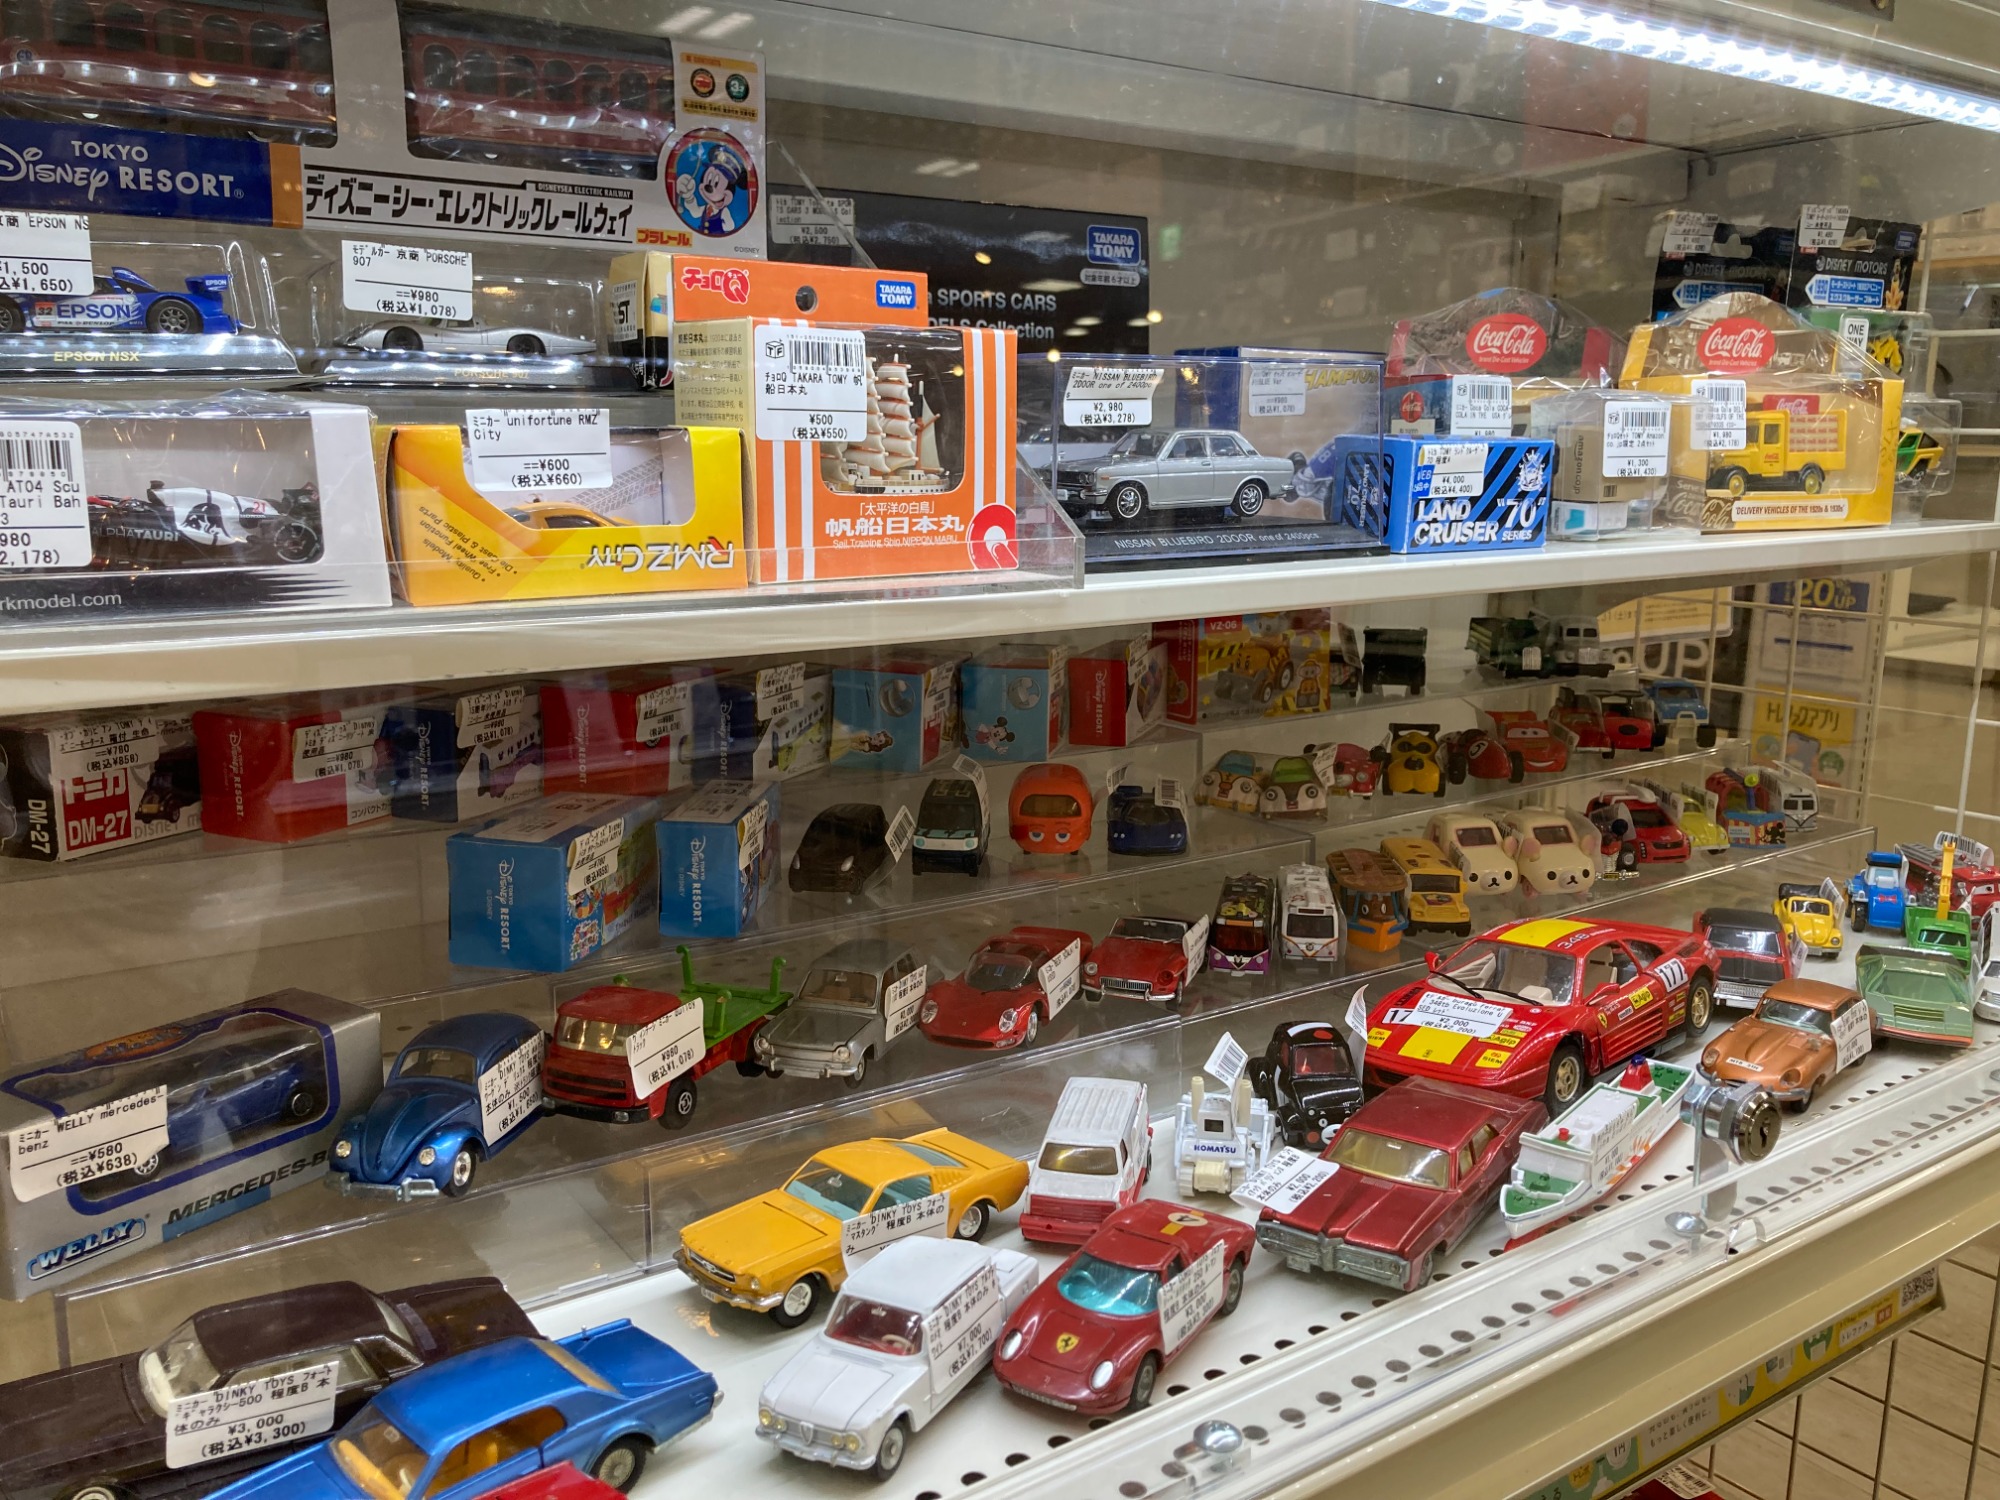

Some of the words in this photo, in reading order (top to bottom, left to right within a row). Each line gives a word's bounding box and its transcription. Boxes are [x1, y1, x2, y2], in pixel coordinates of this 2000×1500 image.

[71, 140, 149, 162] TOKYO
[119, 165, 234, 199] RESORT
[604, 188, 632, 199] RAILWAY
[306, 174, 633, 237] ディズニーシー・エレクトリックレールウェイ
[29, 215, 67, 230] EPSON
[637, 228, 692, 247] プラレール
[1093, 231, 1134, 246] TAKARA
[397, 249, 419, 261] 京商
[426, 253, 468, 267] PORSCHE
[1092, 245, 1134, 260] TOMY
[352, 256, 371, 267] 907
[1825, 257, 1853, 272] DISNEY
[1854, 260, 1888, 275] MOTORS
[880, 284, 912, 296] TAKARA
[880, 294, 912, 305] TOMY
[938, 289, 1005, 310] SPORTS
[1011, 293, 1056, 311] CARS
[37, 306, 53, 316] 32
[57, 303, 132, 319] EPSON
[377, 300, 457, 318] (税込¥1,078)
[1848, 324, 1864, 335] ONE
[54, 352, 104, 362] EPSON
[110, 351, 139, 362] NSX
[455, 368, 508, 379] PORSCHE
[793, 373, 823, 384] TAKARA
[829, 374, 847, 384] TOMY
[1093, 371, 1121, 381] NISSAN
[765, 383, 807, 396] 船日本丸
[1072, 380, 1095, 388] 2DOOR
[1093, 402, 1124, 413] ¥2,980
[474, 416, 500, 427] ミニカー
[507, 413, 572, 427] unifortune
[578, 414, 598, 425] RMZ
[809, 414, 833, 426] ¥500
[1079, 413, 1135, 425] (税込¥3,278)
[474, 428, 501, 441] City
[792, 427, 848, 440] (税込¥550)
[7, 480, 43, 493] AT04
[53, 481, 80, 494] Scu
[511, 472, 583, 488] (税込¥660)
[1442, 476, 1465, 484] ¥4,000
[1431, 485, 1473, 495] (税込¥4,400)
[54, 495, 81, 508] Bah
[859, 501, 935, 515] 「太平洋の白鳥」
[1764, 505, 1789, 514] VEHICLES
[1790, 505, 1798, 514] OF
[1799, 505, 1808, 514] THE
[419, 506, 443, 525] Parts
[1417, 500, 1471, 521] LAND
[420, 520, 454, 546] Function
[443, 522, 470, 544] Plastic
[825, 514, 964, 538] 帆船日本丸
[1414, 521, 1499, 545] CRUISER
[0, 533, 31, 547] 980
[902, 536, 932, 545] NIPPON
[1114, 536, 1155, 549] NISSAN
[1160, 534, 1213, 547] BLUEBIRD
[1217, 533, 1255, 544] 2DOOR
[1502, 530, 1532, 541] SERIES
[423, 539, 453, 562] Models
[453, 544, 477, 562] Wheel
[470, 541, 478, 549] &
[479, 547, 499, 562] Cast
[647, 538, 734, 571] RMZ
[479, 561, 496, 575] Free
[1834, 595, 1856, 610] UP
[1209, 620, 1238, 631] VZ-06
[87, 753, 138, 772] (税込¥858)
[315, 761, 363, 777] (税込¥1,078)
[578, 746, 588, 784] RESORT
[420, 764, 429, 807] RESORT
[234, 777, 244, 818] RESORT
[27, 799, 50, 854] DM-27
[68, 810, 128, 846] DM-27
[693, 883, 702, 922] RESORT
[500, 907, 510, 949] RESORT
[1557, 933, 1590, 949] 348
[1657, 961, 1685, 991] 177
[1453, 1005, 1494, 1016] Evoluzione
[1497, 1035, 1517, 1047] Agip
[661, 1046, 679, 1062] ¥980
[499, 1061, 516, 1080] DINKY
[648, 1049, 694, 1085] (税込¥1,078)
[507, 1086, 530, 1110] ¥1,500
[19, 1128, 50, 1143] ミニカー
[57, 1113, 95, 1134] WELLY
[100, 1094, 164, 1120] mercedes-
[18, 1139, 49, 1155] benz
[1194, 1144, 1236, 1154] KOMATSU
[57, 1153, 138, 1187] (税込¥638)
[847, 1221, 866, 1233] ミニカー
[871, 1210, 897, 1224] DINKY
[902, 1202, 922, 1216] TOYS
[886, 1216, 912, 1231] 程度B
[916, 1205, 944, 1220] 本体の
[37, 1217, 138, 1269] WELLY
[846, 1244, 855, 1254] み
[1841, 1321, 1868, 1342] トレファク
[175, 1400, 207, 1414] ミニカー
[216, 1384, 255, 1401] DINKY
[264, 1375, 294, 1392] TOYS
[271, 1383, 309, 1400] 程度B
[317, 1378, 330, 1390] 本
[174, 1415, 220, 1433] 体のみ
[227, 1414, 284, 1435] ¥3,000
[202, 1422, 306, 1457] (税込¥3,300)
